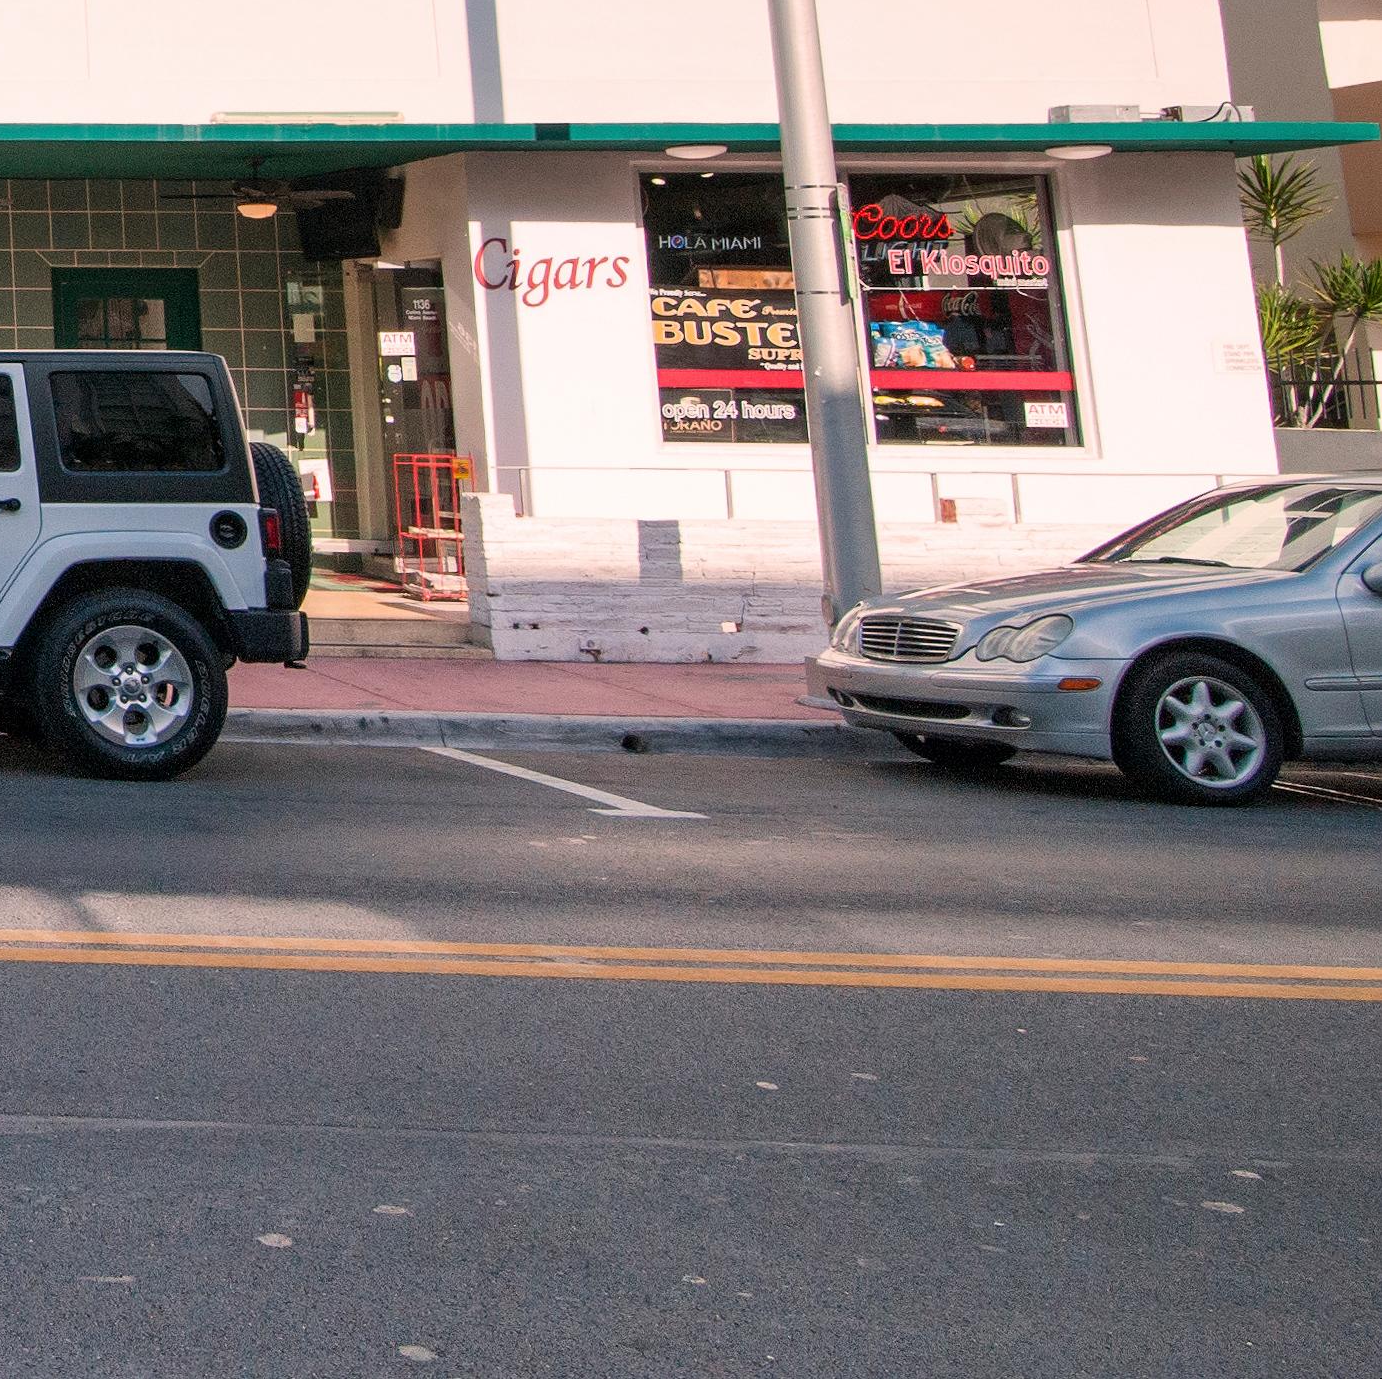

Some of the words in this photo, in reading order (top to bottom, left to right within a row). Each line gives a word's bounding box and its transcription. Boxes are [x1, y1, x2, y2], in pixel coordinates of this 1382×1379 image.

[853, 204, 956, 240] Coors
[711, 236, 762, 251] MIAMI
[474, 238, 630, 307] Cigars
[887, 249, 913, 275] El
[921, 248, 1050, 279] Kiosquito
[412, 299, 431, 310] 1136
[383, 333, 413, 343] ATM
[652, 321, 798, 348] BUSTE
[748, 348, 804, 360] SUPR
[662, 403, 710, 422] open
[713, 400, 739, 419] 24
[741, 400, 796, 420] hours
[1029, 404, 1065, 414] ATM
